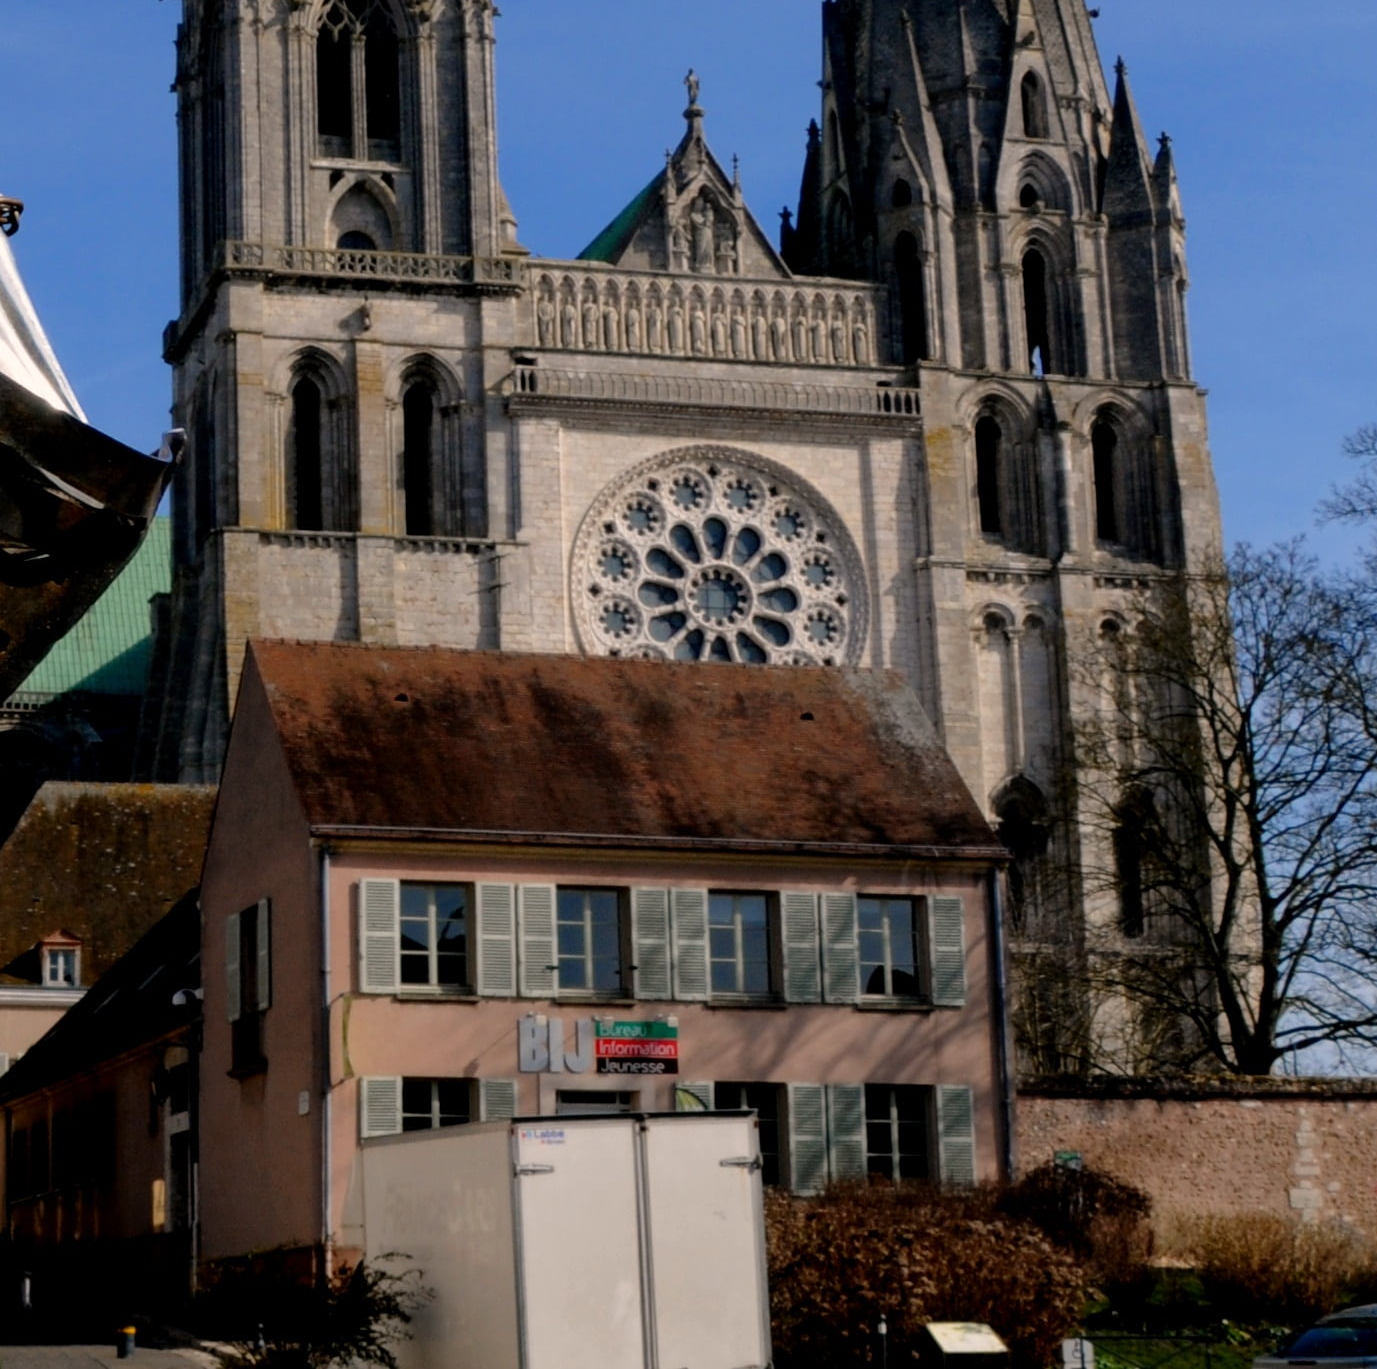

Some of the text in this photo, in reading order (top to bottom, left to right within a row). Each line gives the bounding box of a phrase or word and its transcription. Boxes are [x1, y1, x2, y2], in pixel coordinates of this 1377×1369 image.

[518, 1018, 591, 1073] BIJ
[599, 1039, 675, 1056] Information
[600, 1058, 665, 1074] Jeunesse
